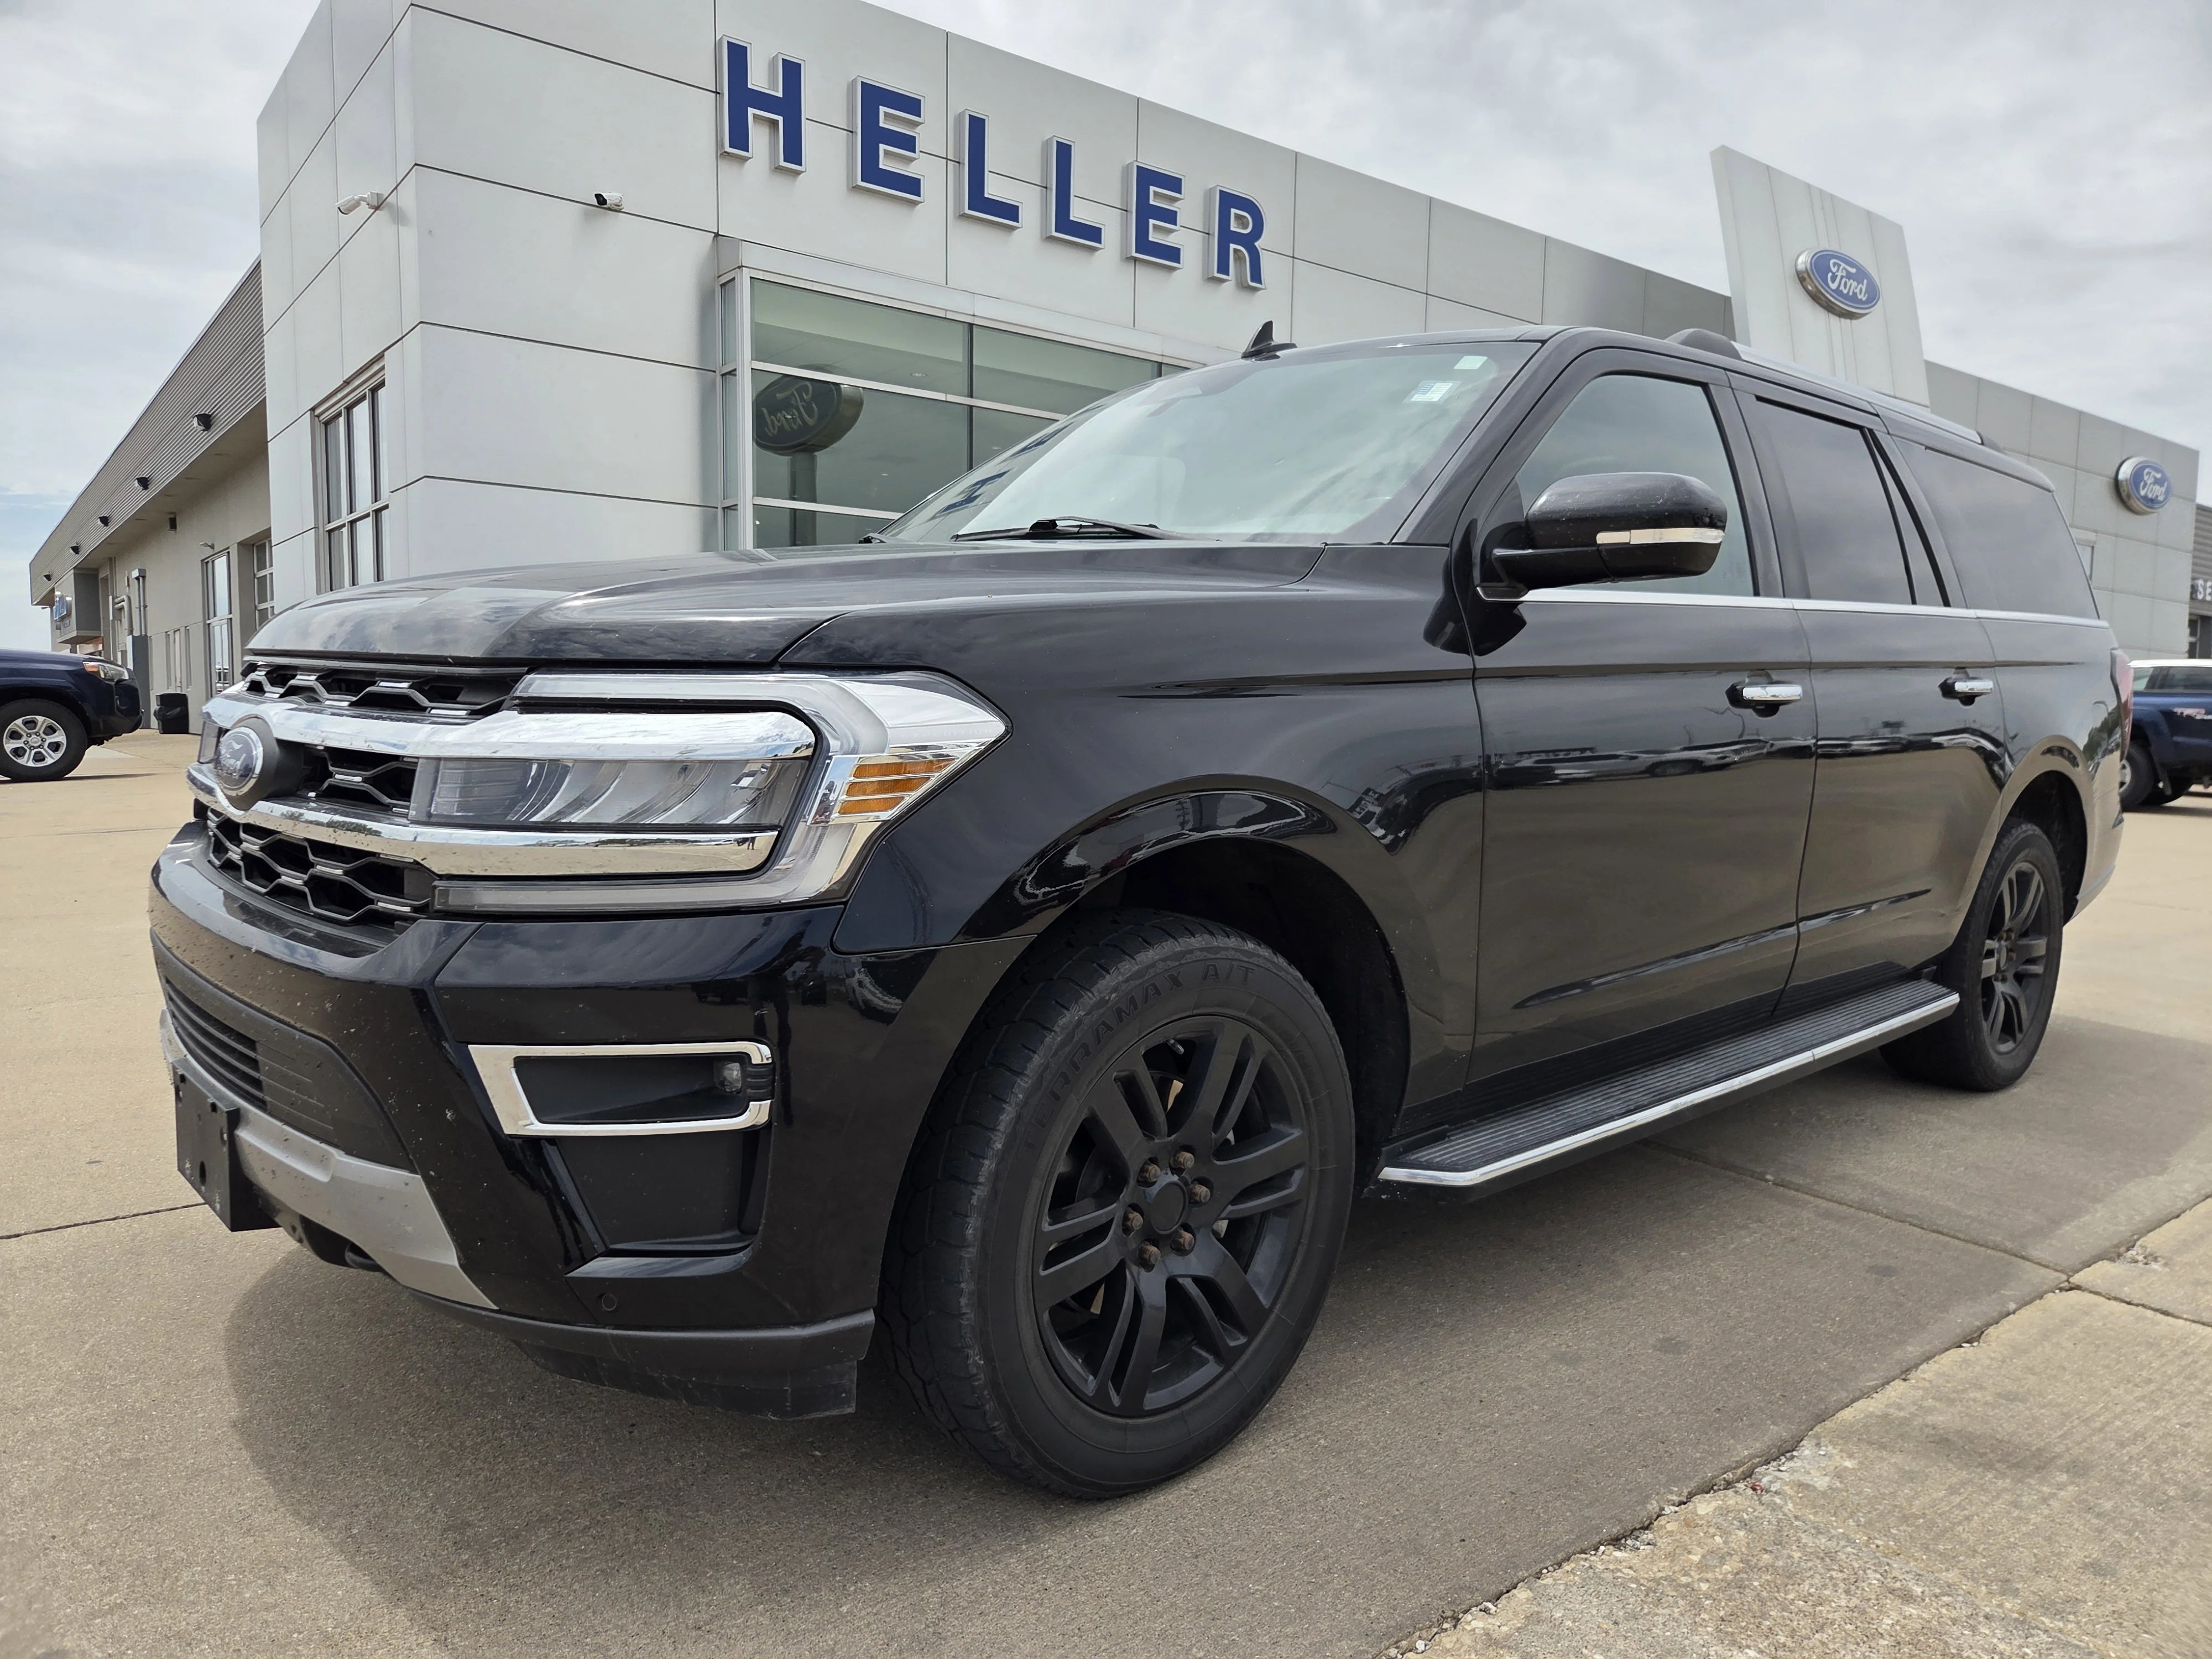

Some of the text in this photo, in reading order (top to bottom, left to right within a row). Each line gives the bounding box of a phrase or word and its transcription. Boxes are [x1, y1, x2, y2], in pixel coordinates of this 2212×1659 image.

[718, 34, 1266, 290] HELLER
[1827, 258, 1868, 301] Ford
[2140, 468, 2168, 501] Ford
[1017, 962, 1256, 1160] TERRAMAX A/T
